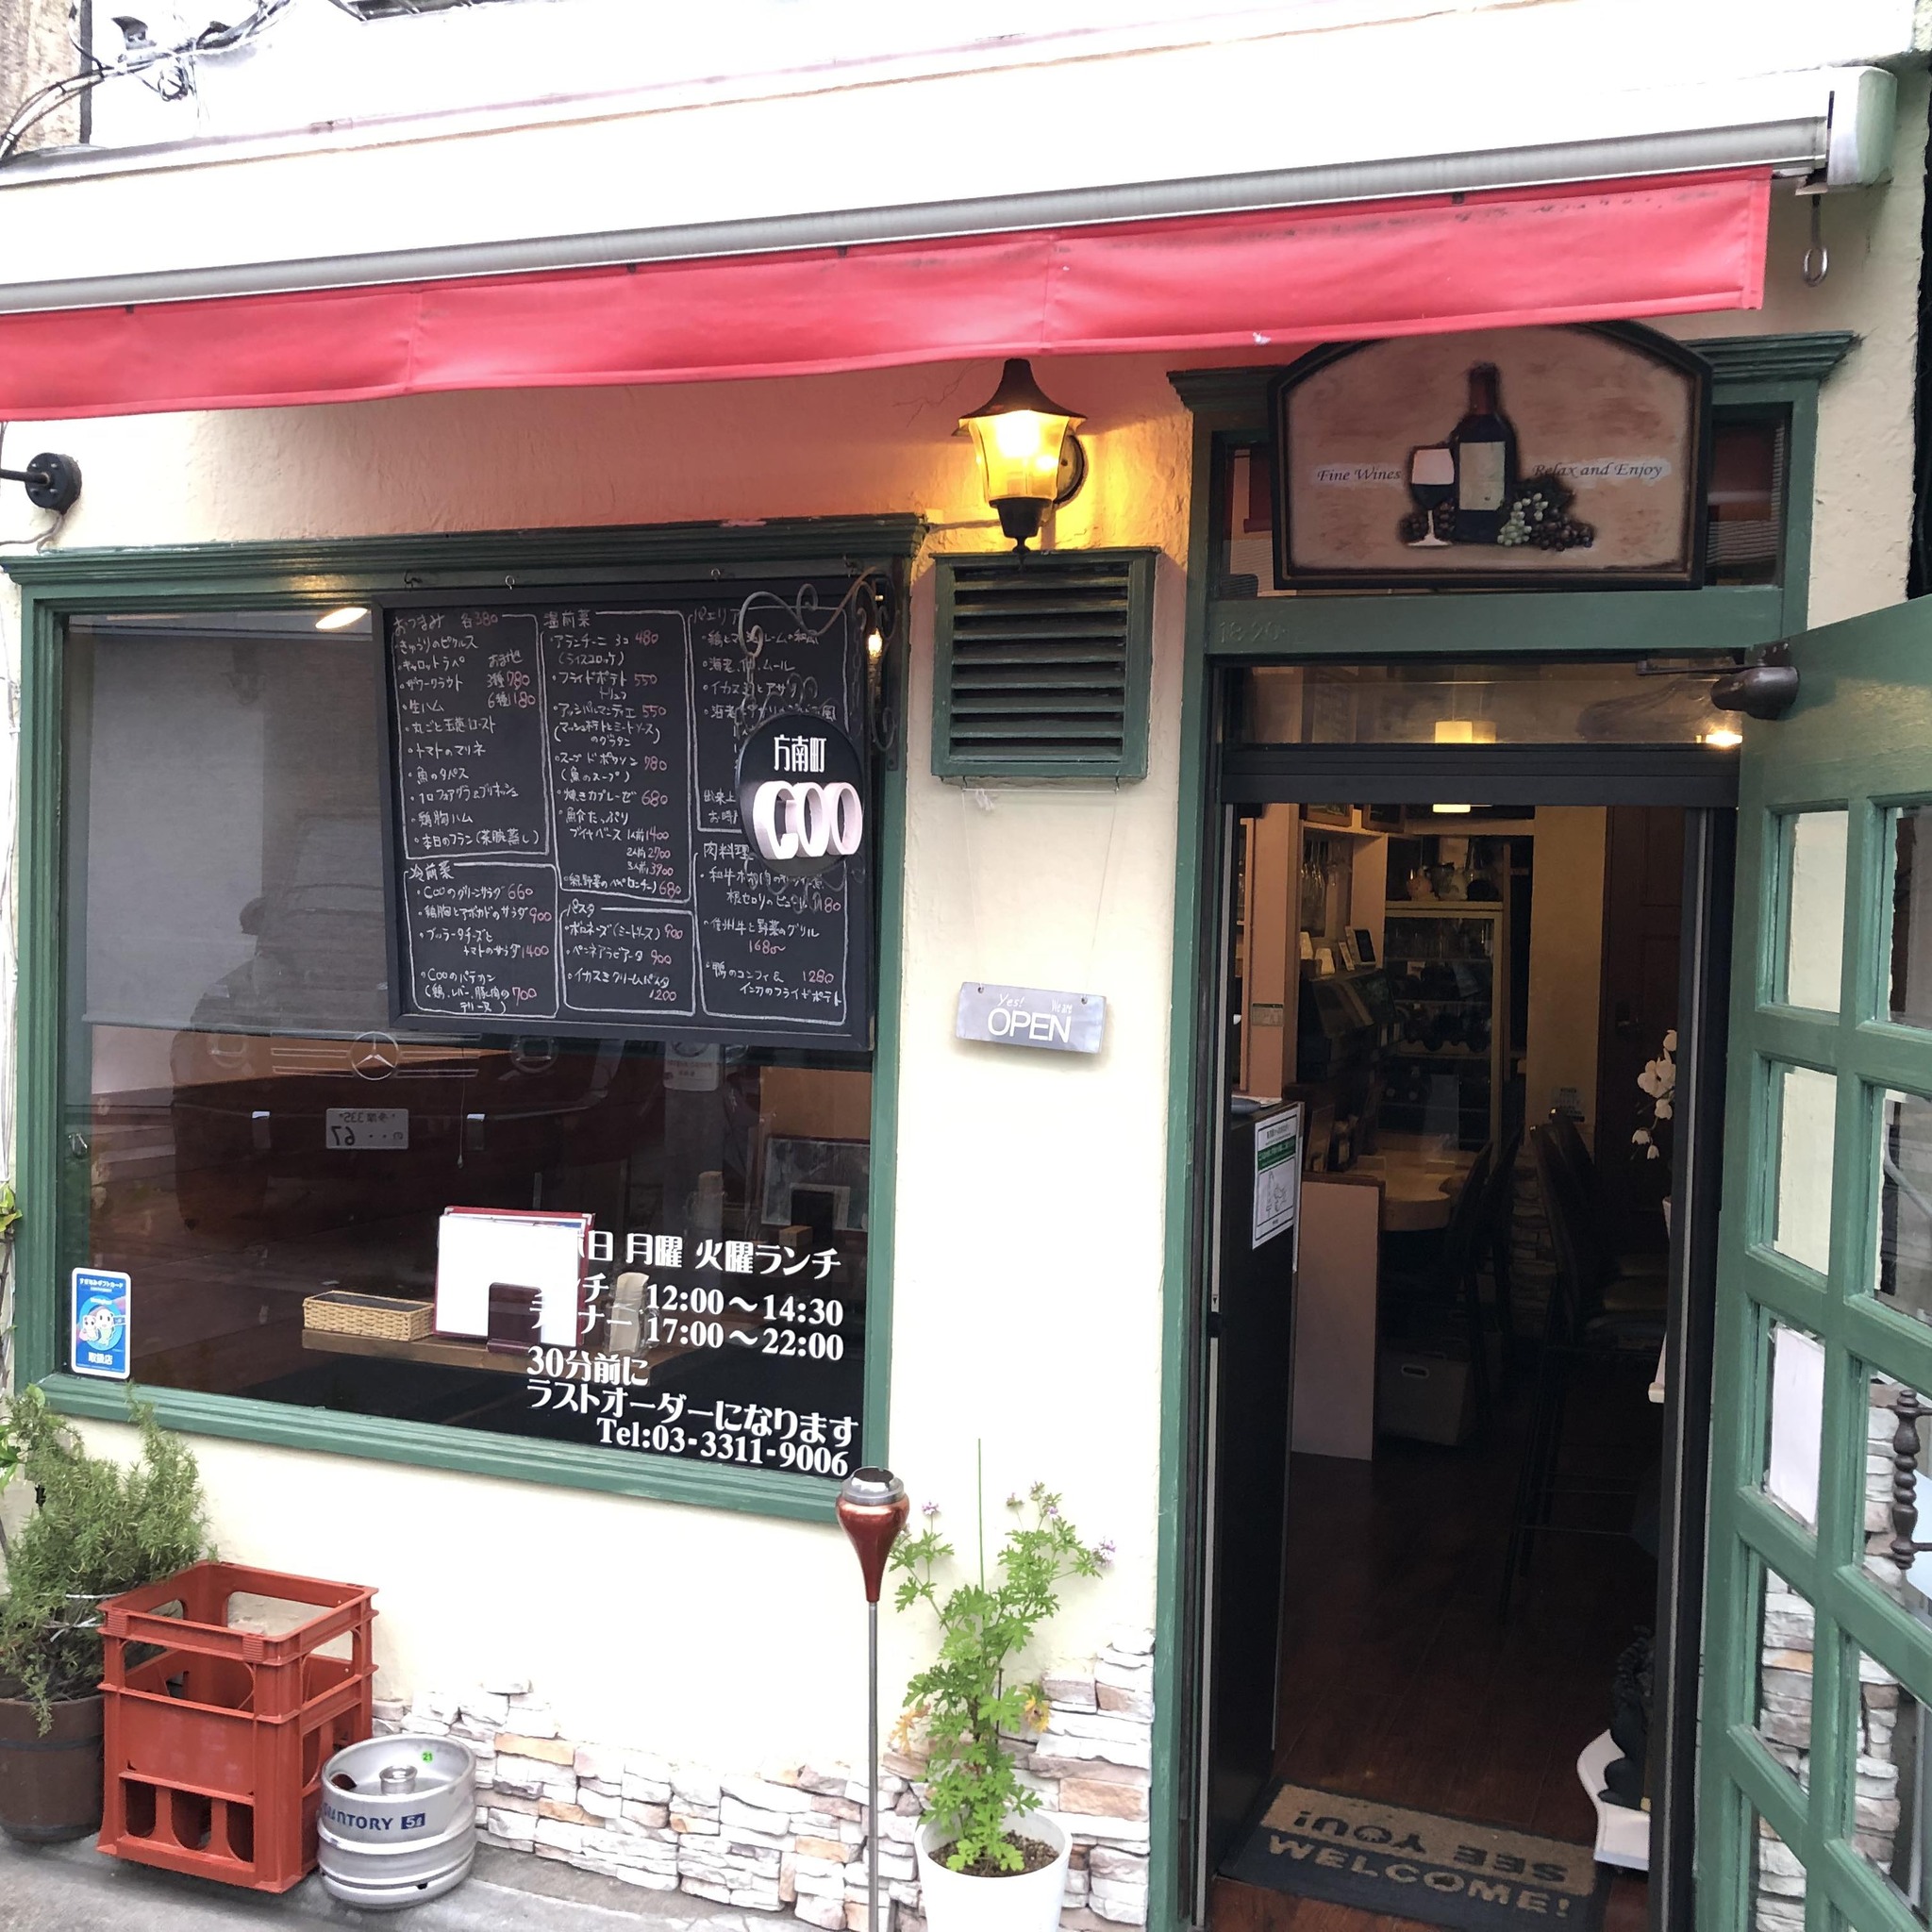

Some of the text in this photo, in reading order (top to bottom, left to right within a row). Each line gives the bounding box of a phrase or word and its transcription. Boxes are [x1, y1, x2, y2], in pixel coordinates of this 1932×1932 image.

[1317, 467, 1402, 482] Fine Wines
[1533, 461, 1663, 480] Relax and Enjoy
[635, 629, 658, 646] 480
[634, 673, 658, 687] 550
[641, 705, 667, 718] 550
[774, 734, 827, 773] 方南町
[644, 756, 667, 771] 780
[641, 790, 668, 807] 680
[508, 884, 534, 900] 660
[659, 881, 681, 899] 680
[651, 949, 672, 965] 900
[803, 969, 834, 983] 1280
[511, 986, 538, 1006] 700
[649, 989, 677, 1001] 1200
[997, 992, 1025, 1008] Yes!
[988, 1008, 1072, 1043] OPEN
[625, 1233, 683, 1268] 月曜
[694, 1238, 841, 1280] 火曜ランチ
[526, 1345, 649, 1387] 30分前に
[526, 1379, 858, 1448] ラストオーダーになります
[596, 1417, 848, 1476] Tel:03-3311-9006
[423, 1753, 433, 1761] 21
[1454, 1843, 1569, 1883] SEE
[1268, 1834, 1571, 1919] WELCOME!
